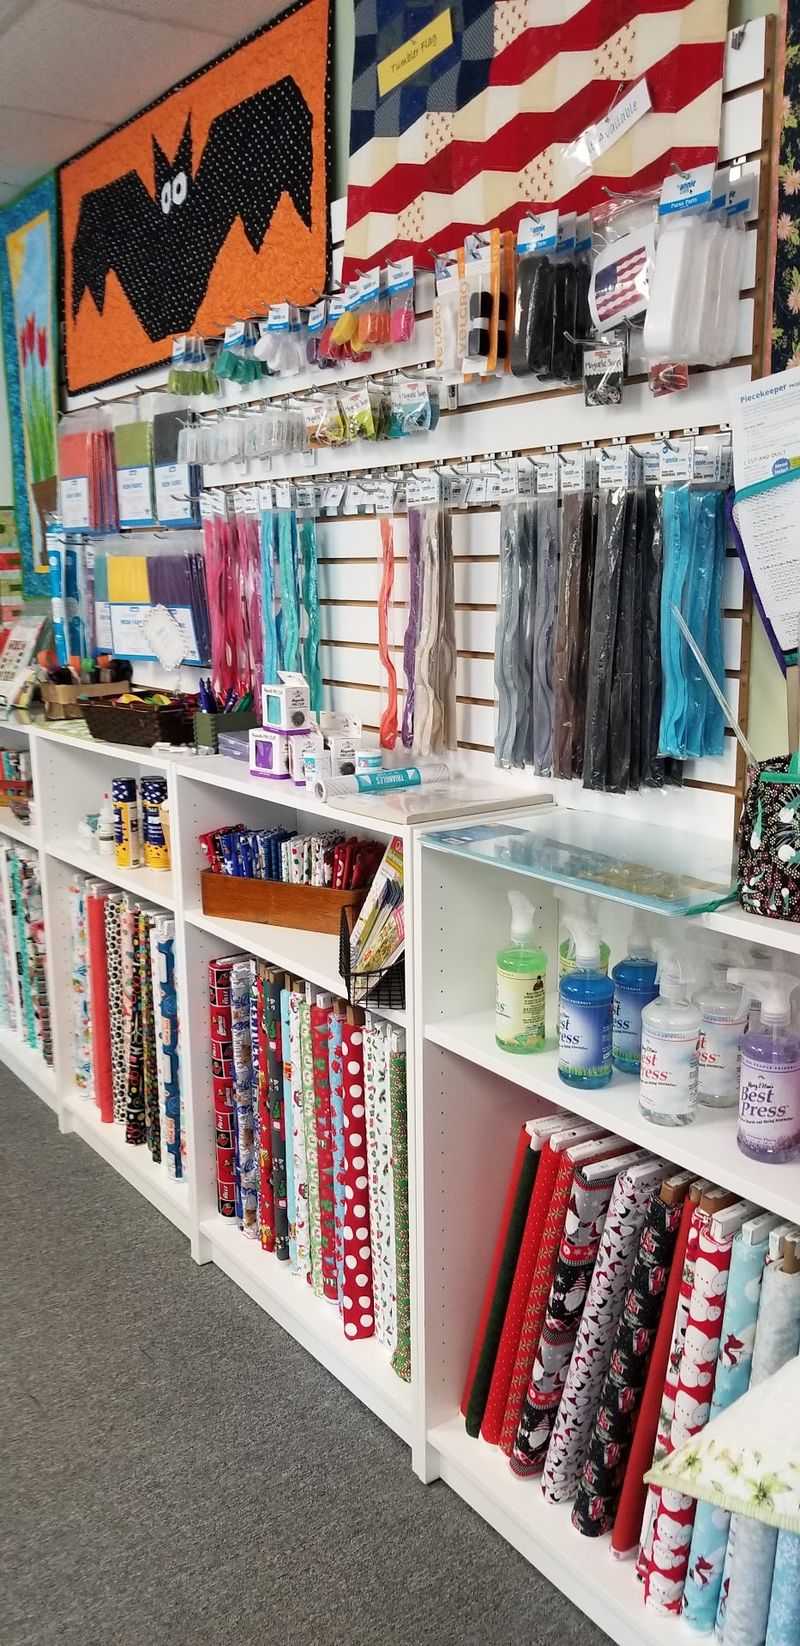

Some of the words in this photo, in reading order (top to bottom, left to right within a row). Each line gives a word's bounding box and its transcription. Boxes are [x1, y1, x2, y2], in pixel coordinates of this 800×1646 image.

[740, 383, 787, 403] Piecekeeper
[641, 1068, 668, 1081] ress
[741, 1086, 774, 1103] Best
[741, 1101, 787, 1118] Press
